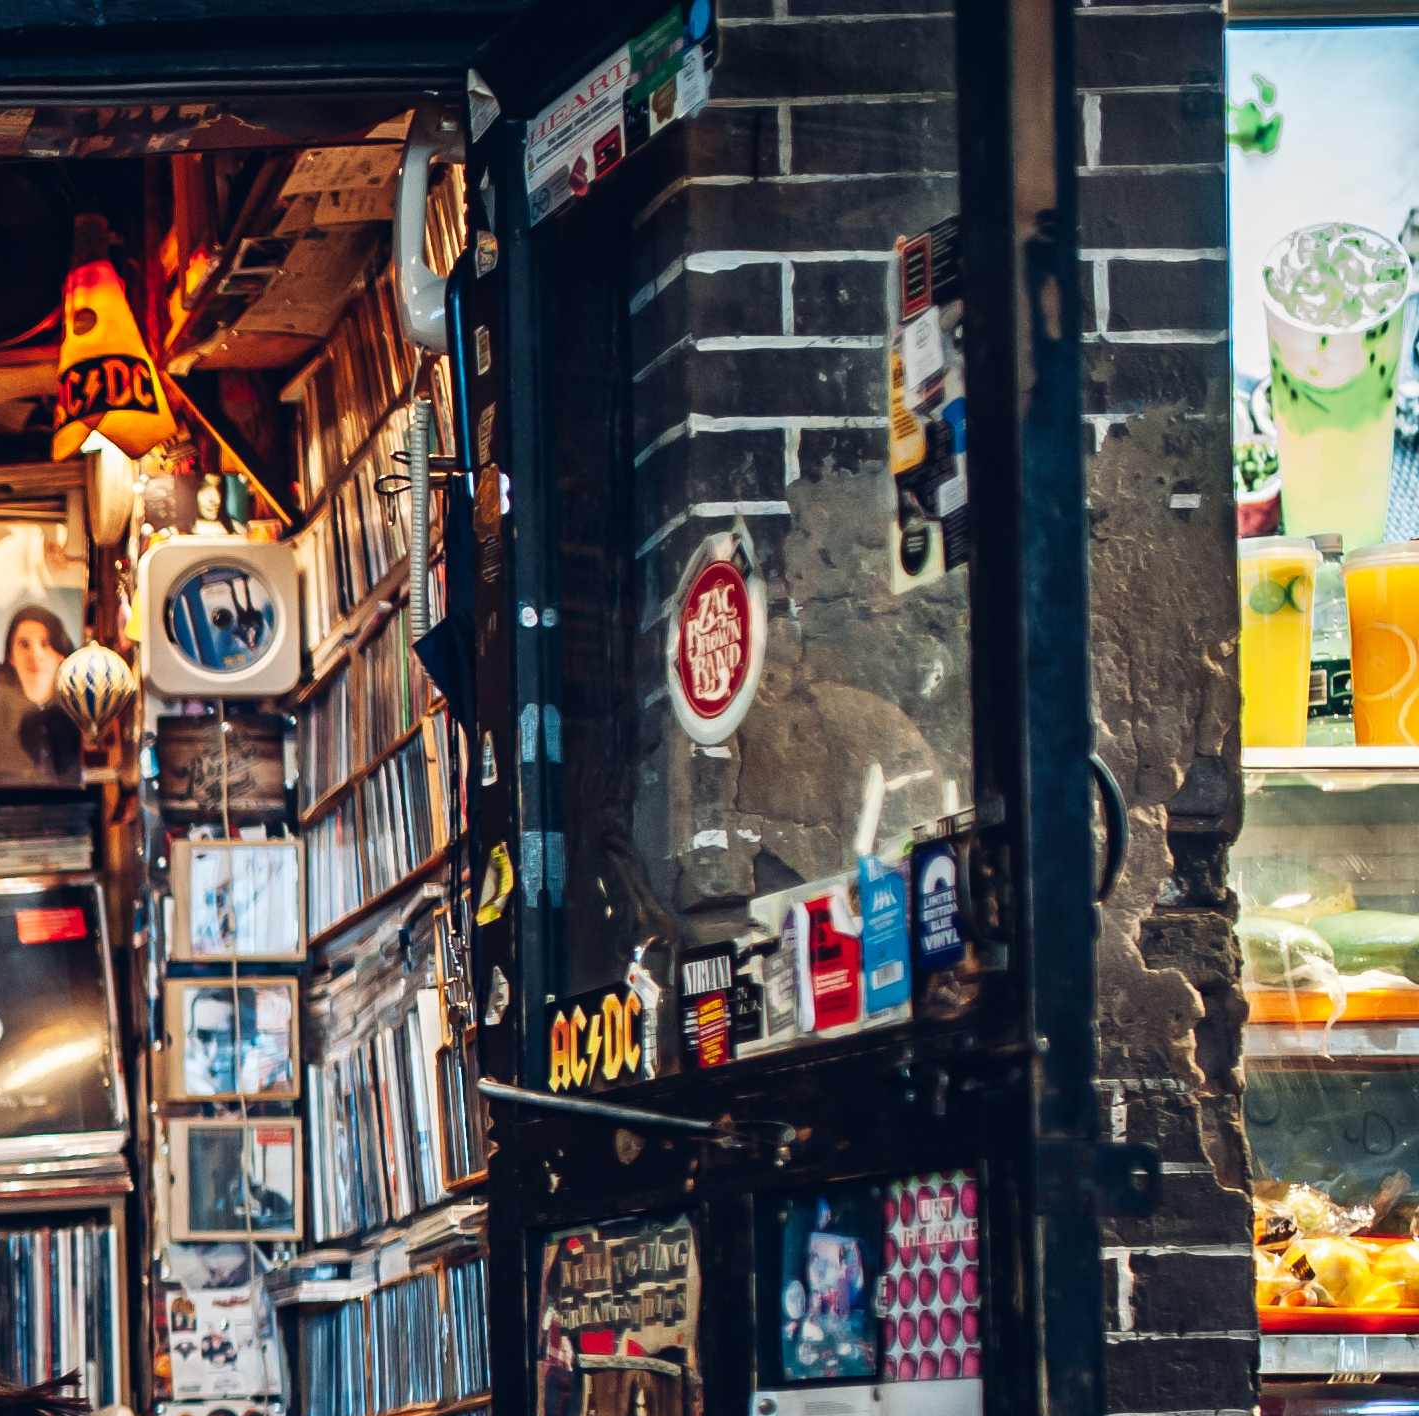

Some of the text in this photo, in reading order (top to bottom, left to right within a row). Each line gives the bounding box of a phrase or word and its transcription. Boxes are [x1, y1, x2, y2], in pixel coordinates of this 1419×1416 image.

[527, 57, 629, 147] HEART
[697, 583, 737, 634] ZAC
[686, 616, 743, 660] BROWN
[690, 641, 744, 695] BAND
[683, 955, 732, 996] NIRVANA
